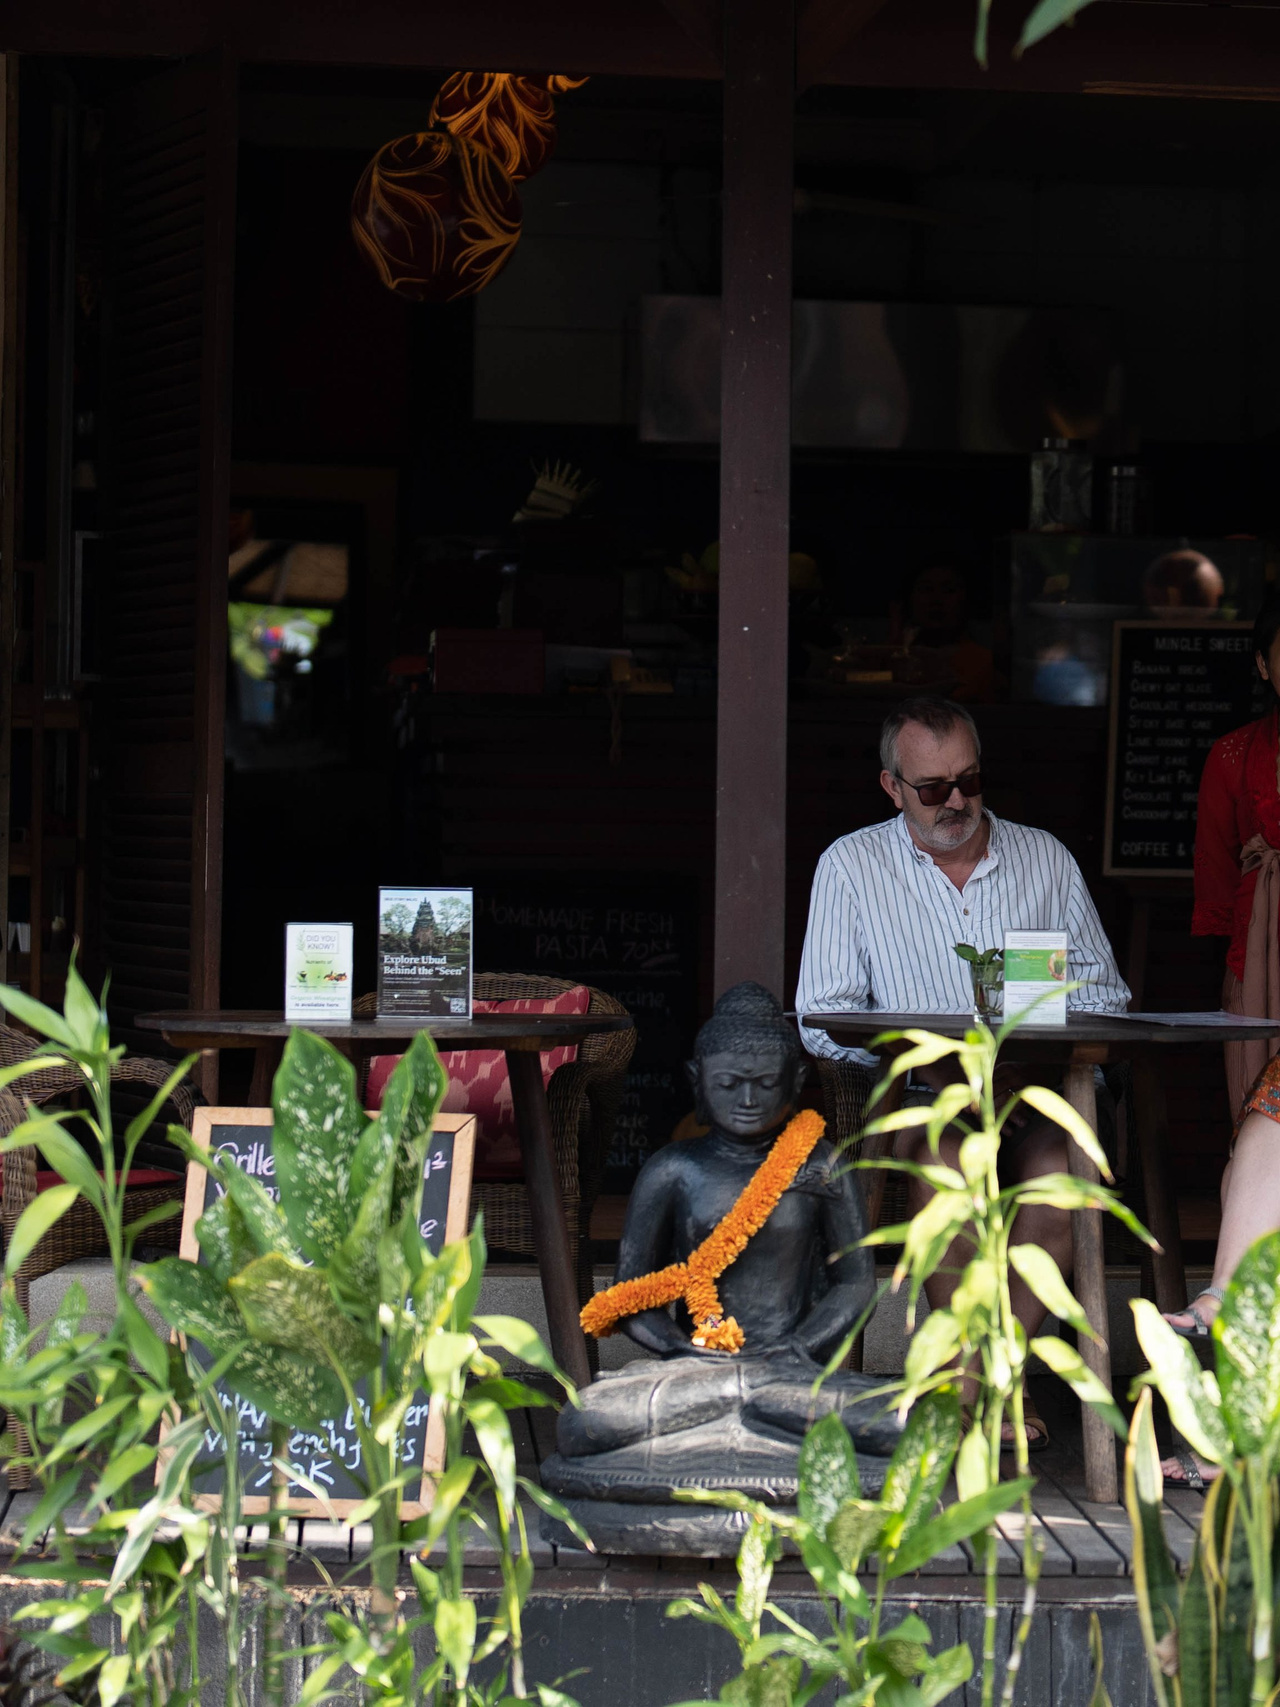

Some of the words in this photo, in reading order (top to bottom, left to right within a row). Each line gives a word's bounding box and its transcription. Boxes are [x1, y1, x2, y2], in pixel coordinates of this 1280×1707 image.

[1154, 637, 1202, 652] MINGLE
[1209, 637, 1253, 652] SWEET
[1121, 841, 1170, 857] COFFEE
[477, 897, 594, 931] HOMEMADE
[606, 909, 674, 935] FRESH
[535, 934, 608, 960] PASTA
[383, 955, 420, 966] Explore
[421, 955, 447, 964] Ubud
[383, 966, 416, 975] Behind
[418, 966, 434, 975] the
